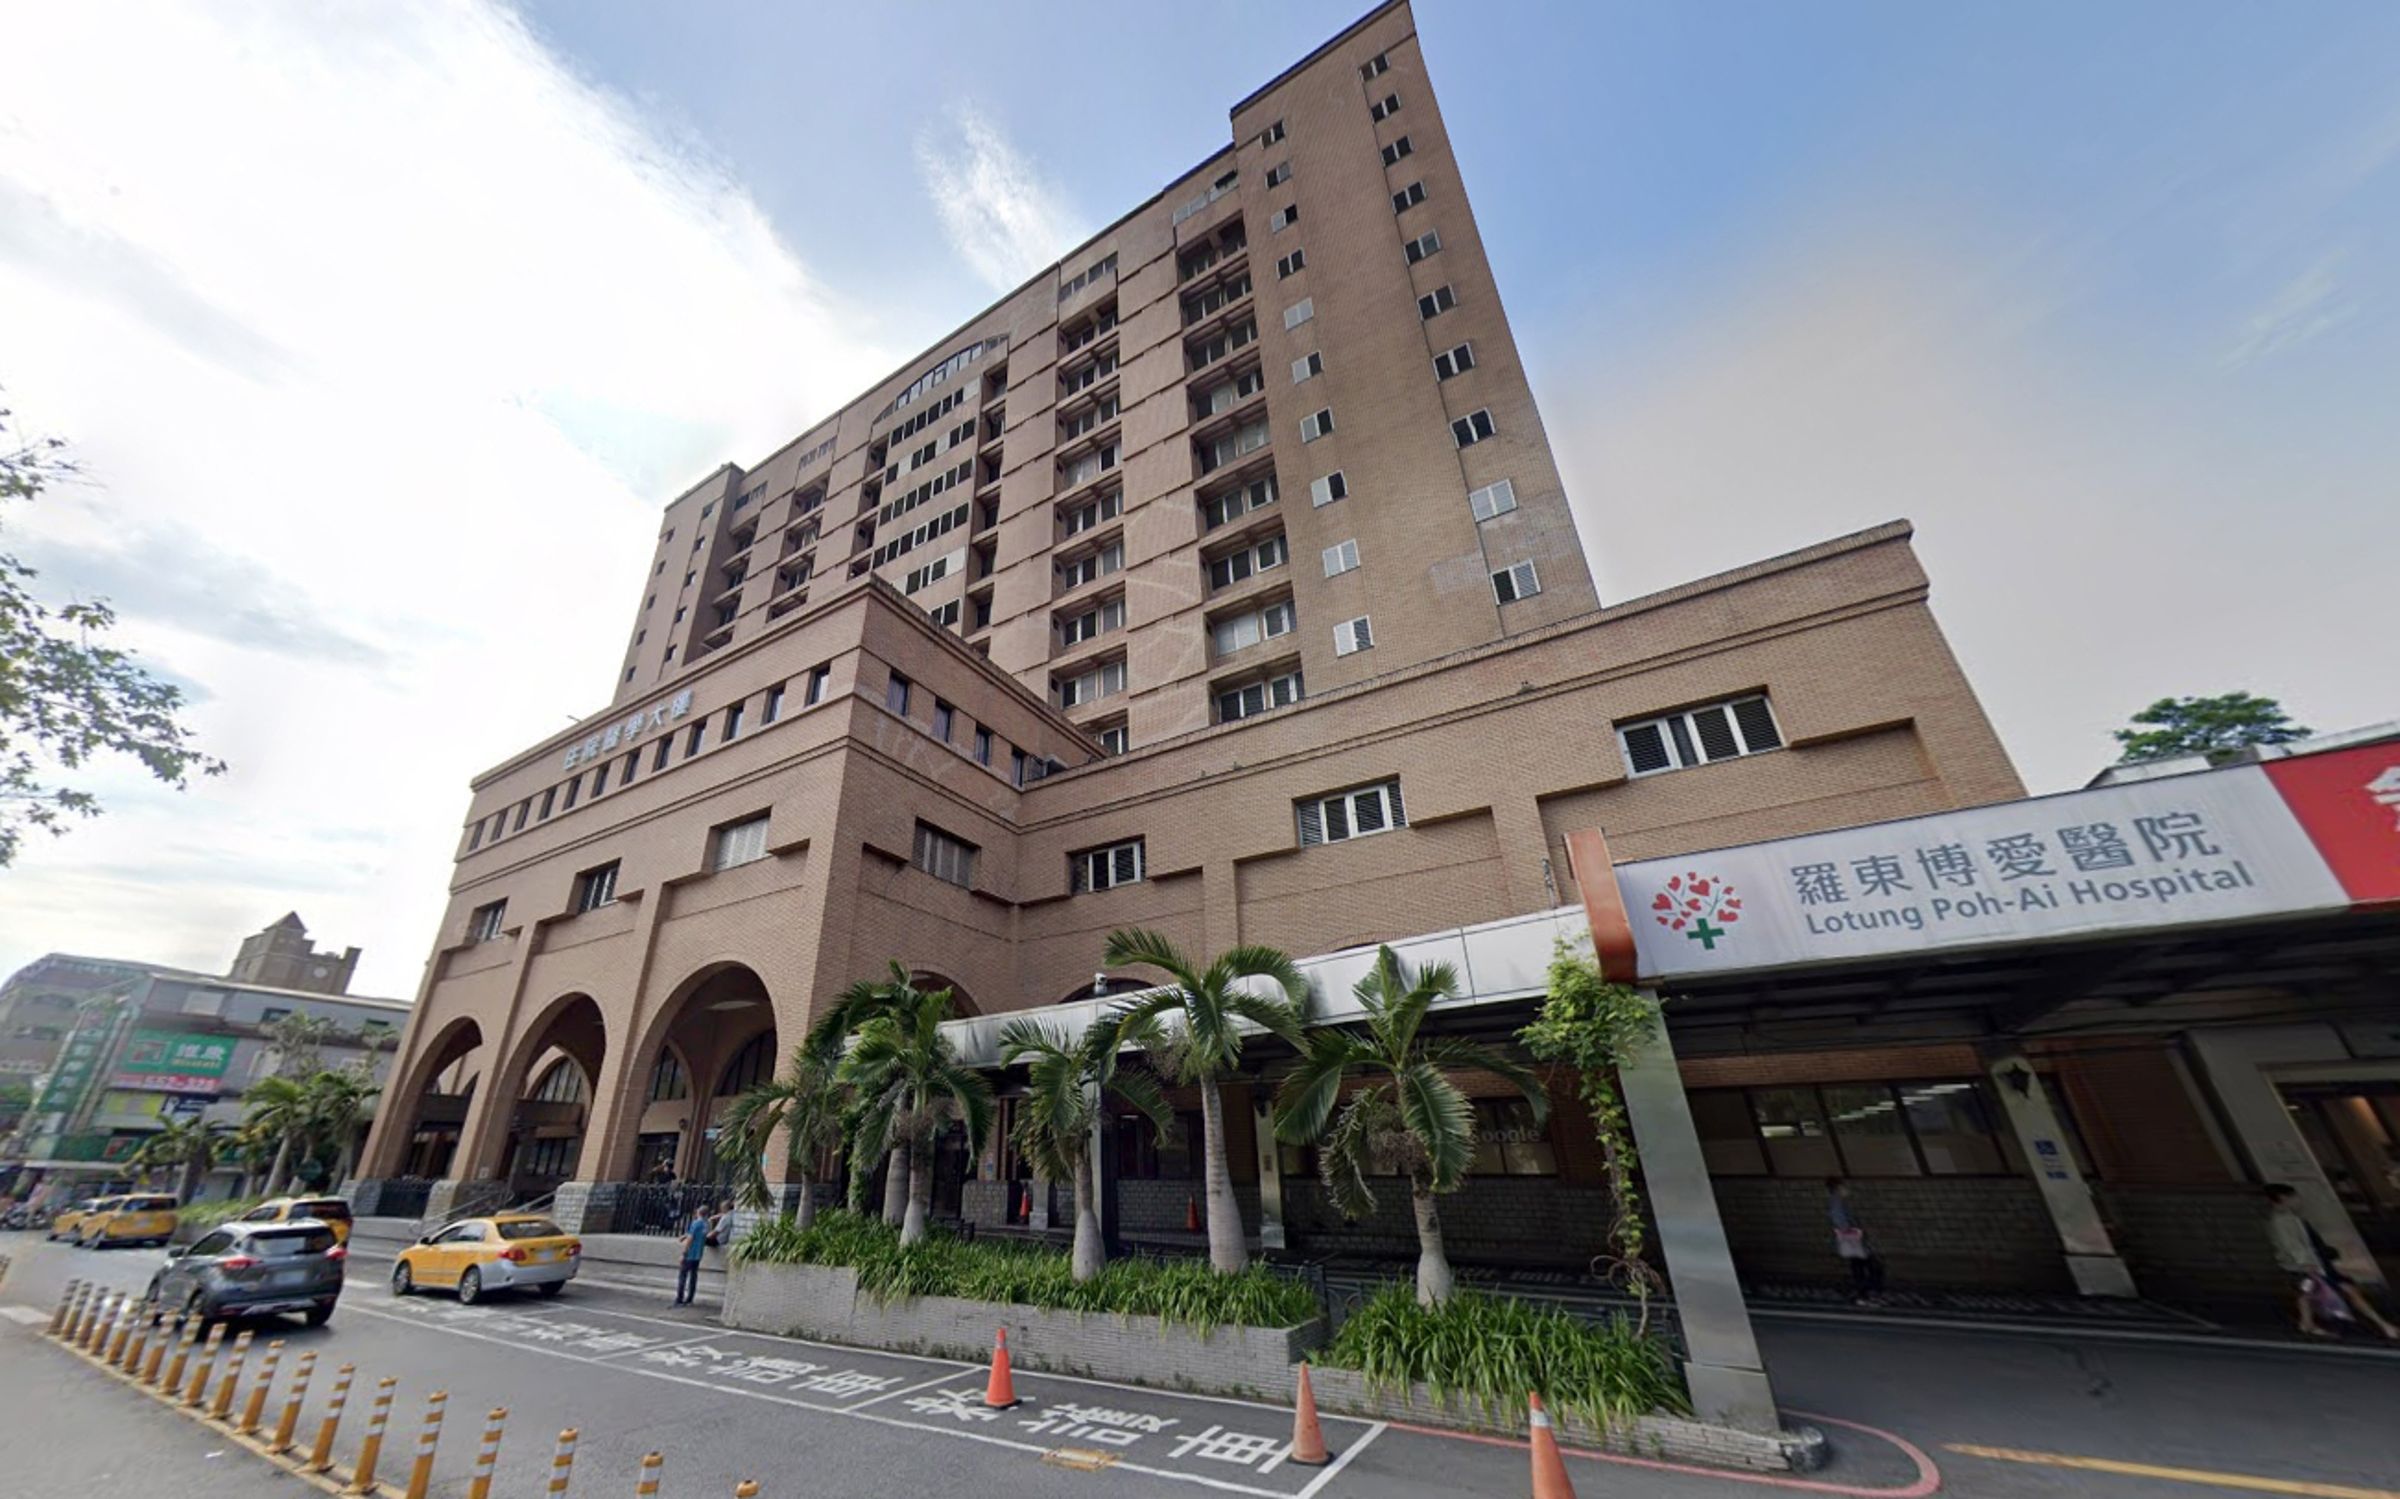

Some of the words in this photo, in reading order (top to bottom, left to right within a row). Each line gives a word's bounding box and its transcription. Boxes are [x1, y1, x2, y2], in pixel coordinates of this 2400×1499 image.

[563, 689, 693, 771] 住院醫學大樓
[1790, 811, 2222, 905] 羅東博愛醫院
[1805, 908, 1924, 935] Lotung
[1932, 884, 2059, 923] Poh-Ai
[2073, 860, 2255, 906] Hospital
[640, 1346, 904, 1398] 救護車
